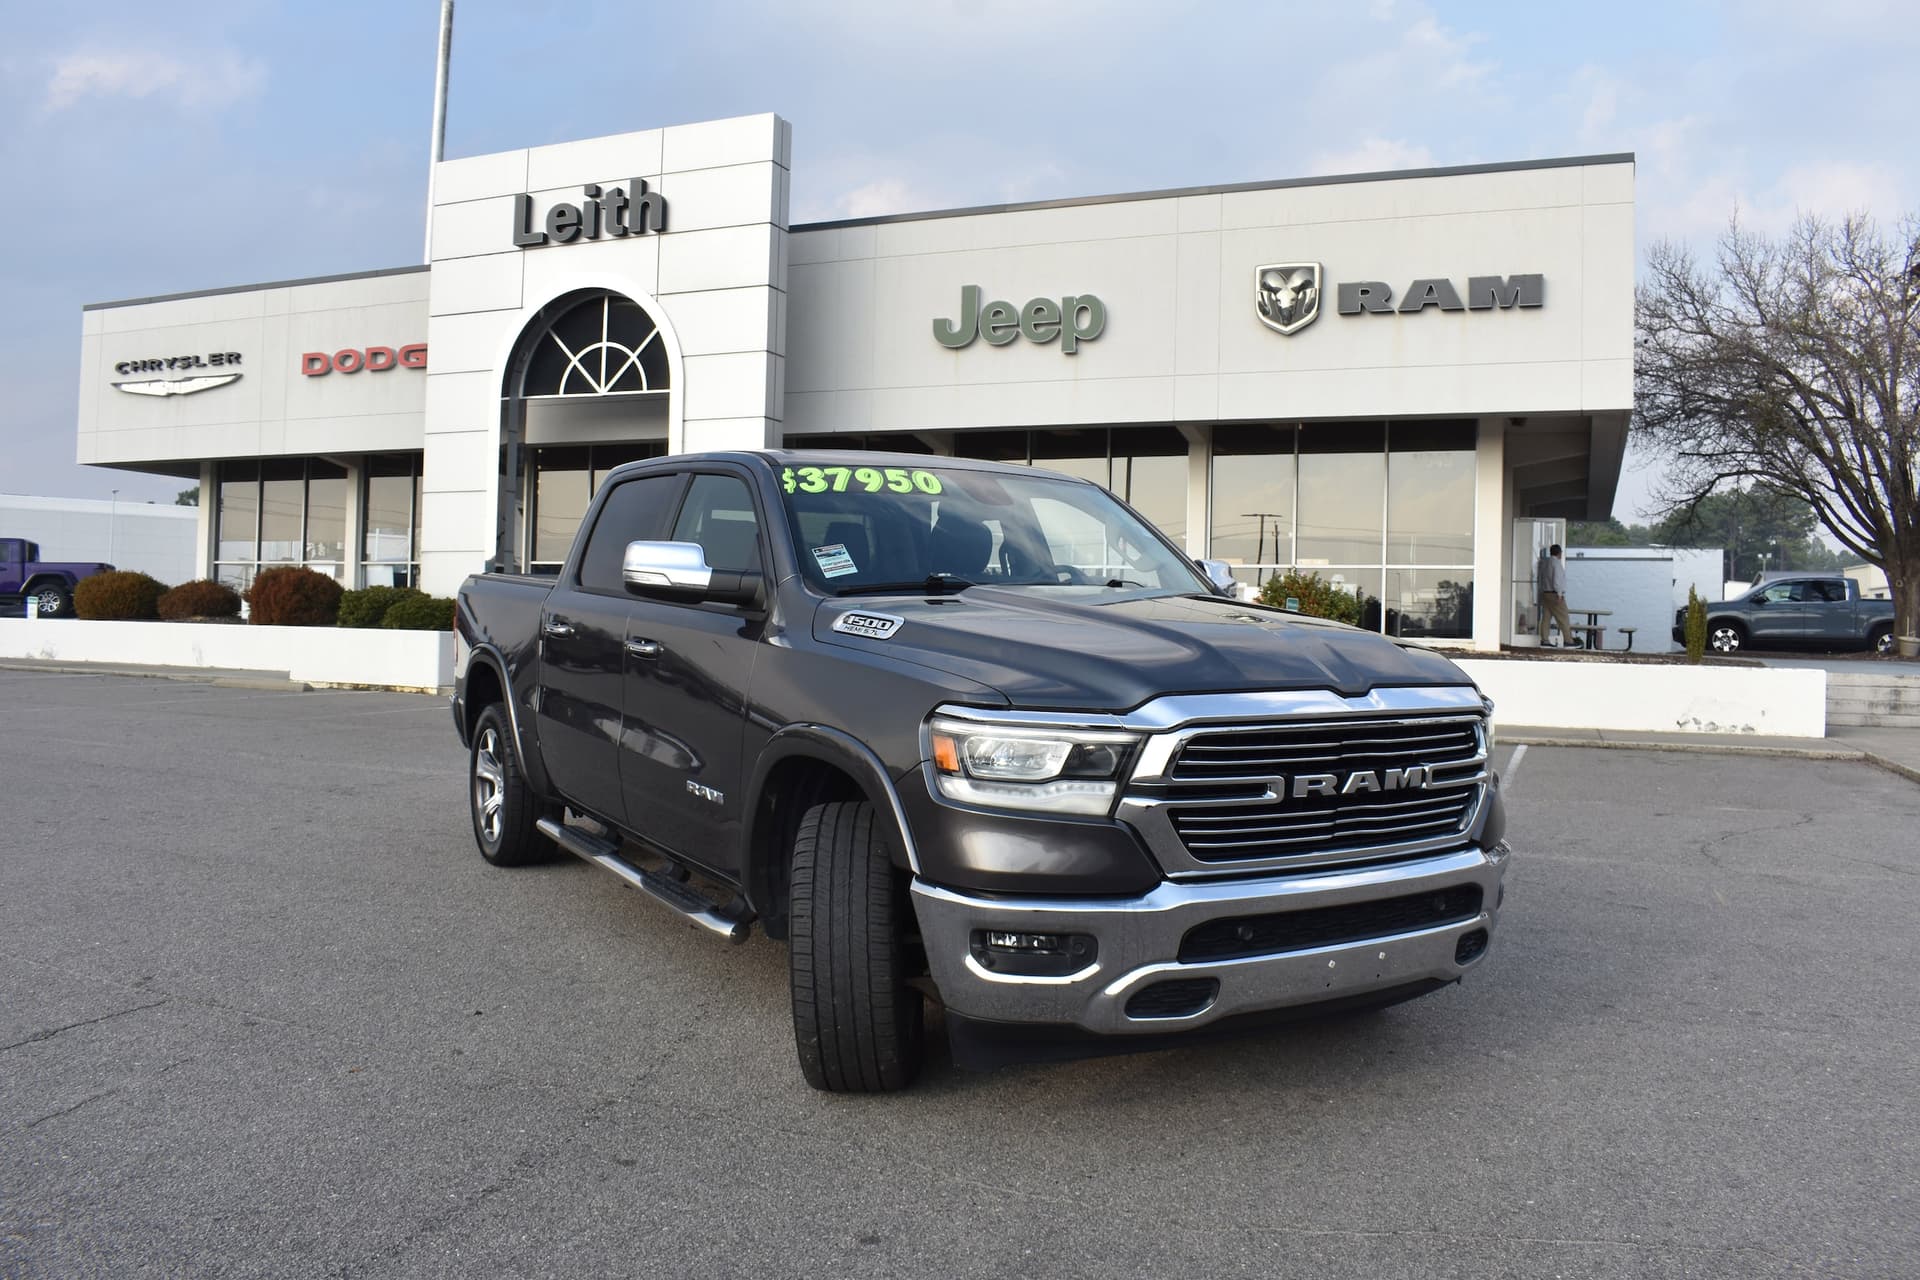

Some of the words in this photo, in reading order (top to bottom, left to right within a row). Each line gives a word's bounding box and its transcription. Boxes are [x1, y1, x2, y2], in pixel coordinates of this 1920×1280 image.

[513, 177, 668, 248] Leith
[1337, 273, 1544, 315] RAM
[932, 284, 1106, 354] Jeep
[114, 351, 242, 375] CHRYSLER
[782, 466, 943, 495] $37950
[843, 615, 893, 630] 1500
[1293, 765, 1425, 798] RAM
